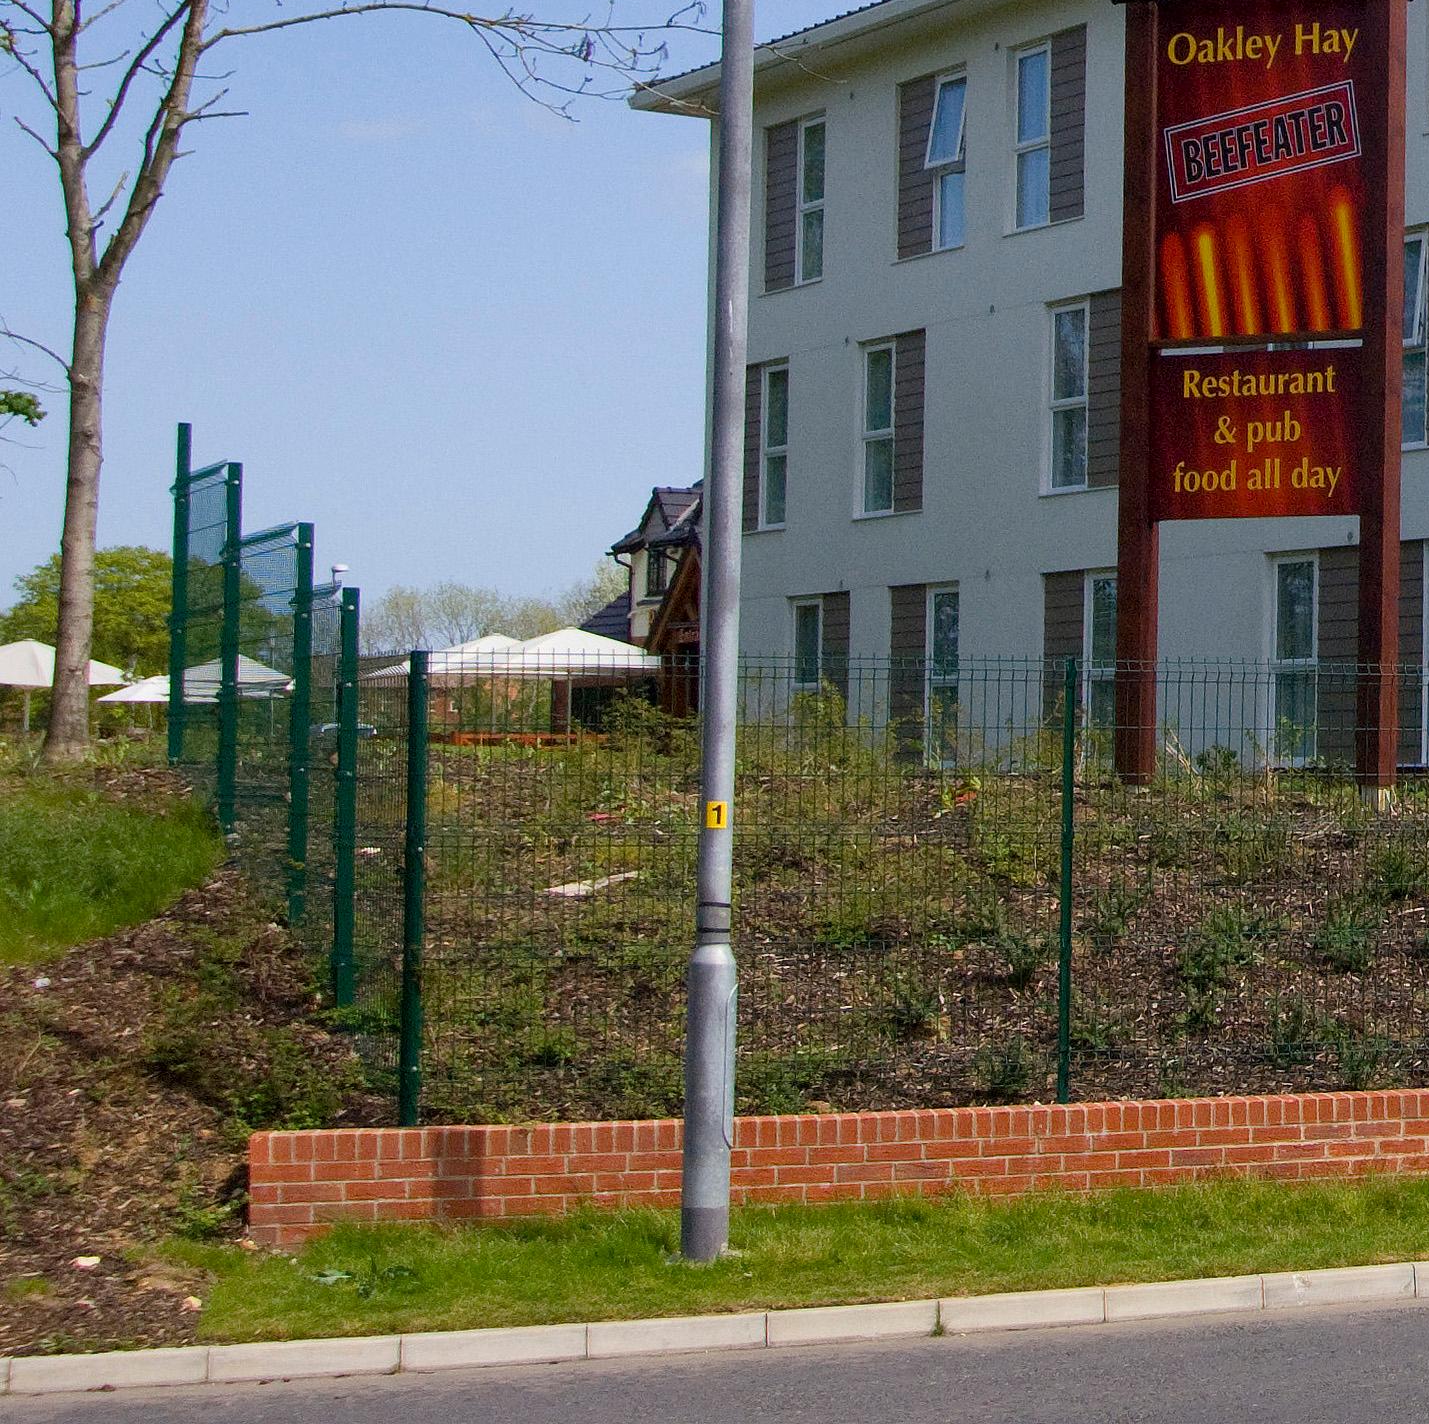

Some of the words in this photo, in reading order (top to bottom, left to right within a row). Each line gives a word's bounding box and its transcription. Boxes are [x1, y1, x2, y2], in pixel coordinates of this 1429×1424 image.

[1167, 25, 1283, 69] Oakley
[1294, 22, 1359, 62] Hay
[1182, 102, 1347, 184] BEEFEATER
[1182, 365, 1336, 399] Restaurant
[1213, 416, 1237, 445] &
[1247, 410, 1301, 452] pub
[1173, 461, 1237, 493] food
[1247, 458, 1282, 490] all
[1291, 455, 1342, 496] day
[711, 804, 722, 825] 1
